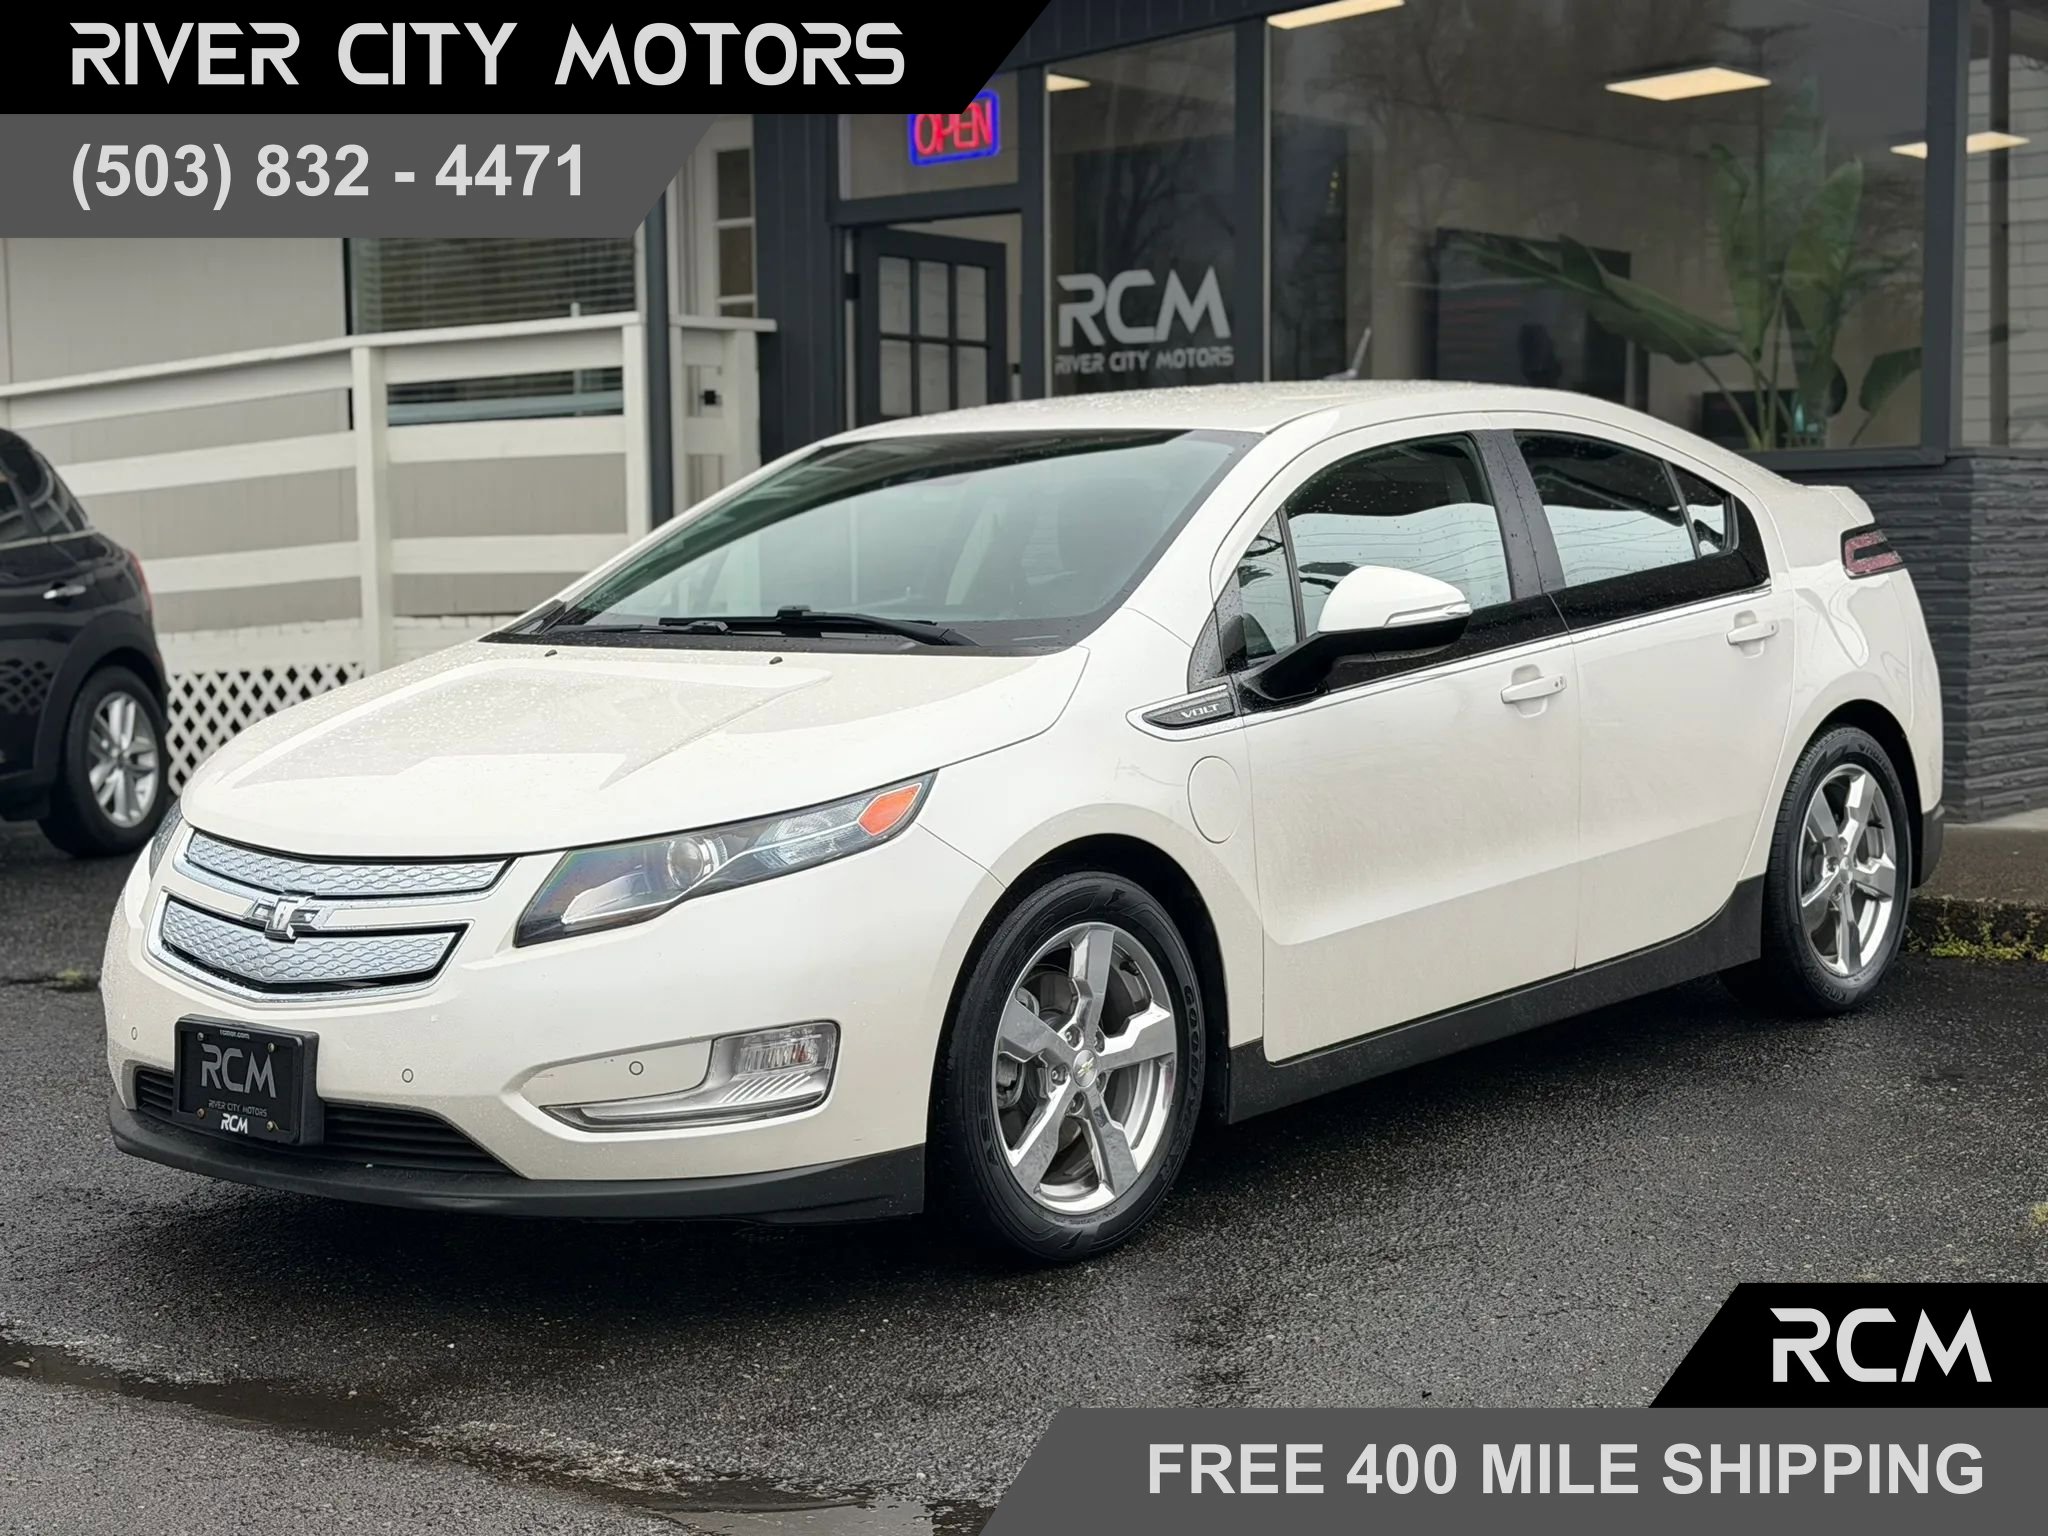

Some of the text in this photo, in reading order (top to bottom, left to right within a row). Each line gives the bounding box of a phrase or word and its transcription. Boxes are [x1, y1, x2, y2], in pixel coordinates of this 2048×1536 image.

[914, 99, 992, 155] OPEN
[1057, 266, 1231, 348] RCM
[1055, 346, 1235, 375] RIVER CITY MOTORS
[1181, 703, 1219, 718] VOLT
[202, 1043, 276, 1098] RCM
[208, 1099, 268, 1118] RIVER CITY MOTORS
[220, 1113, 248, 1134] RCM
